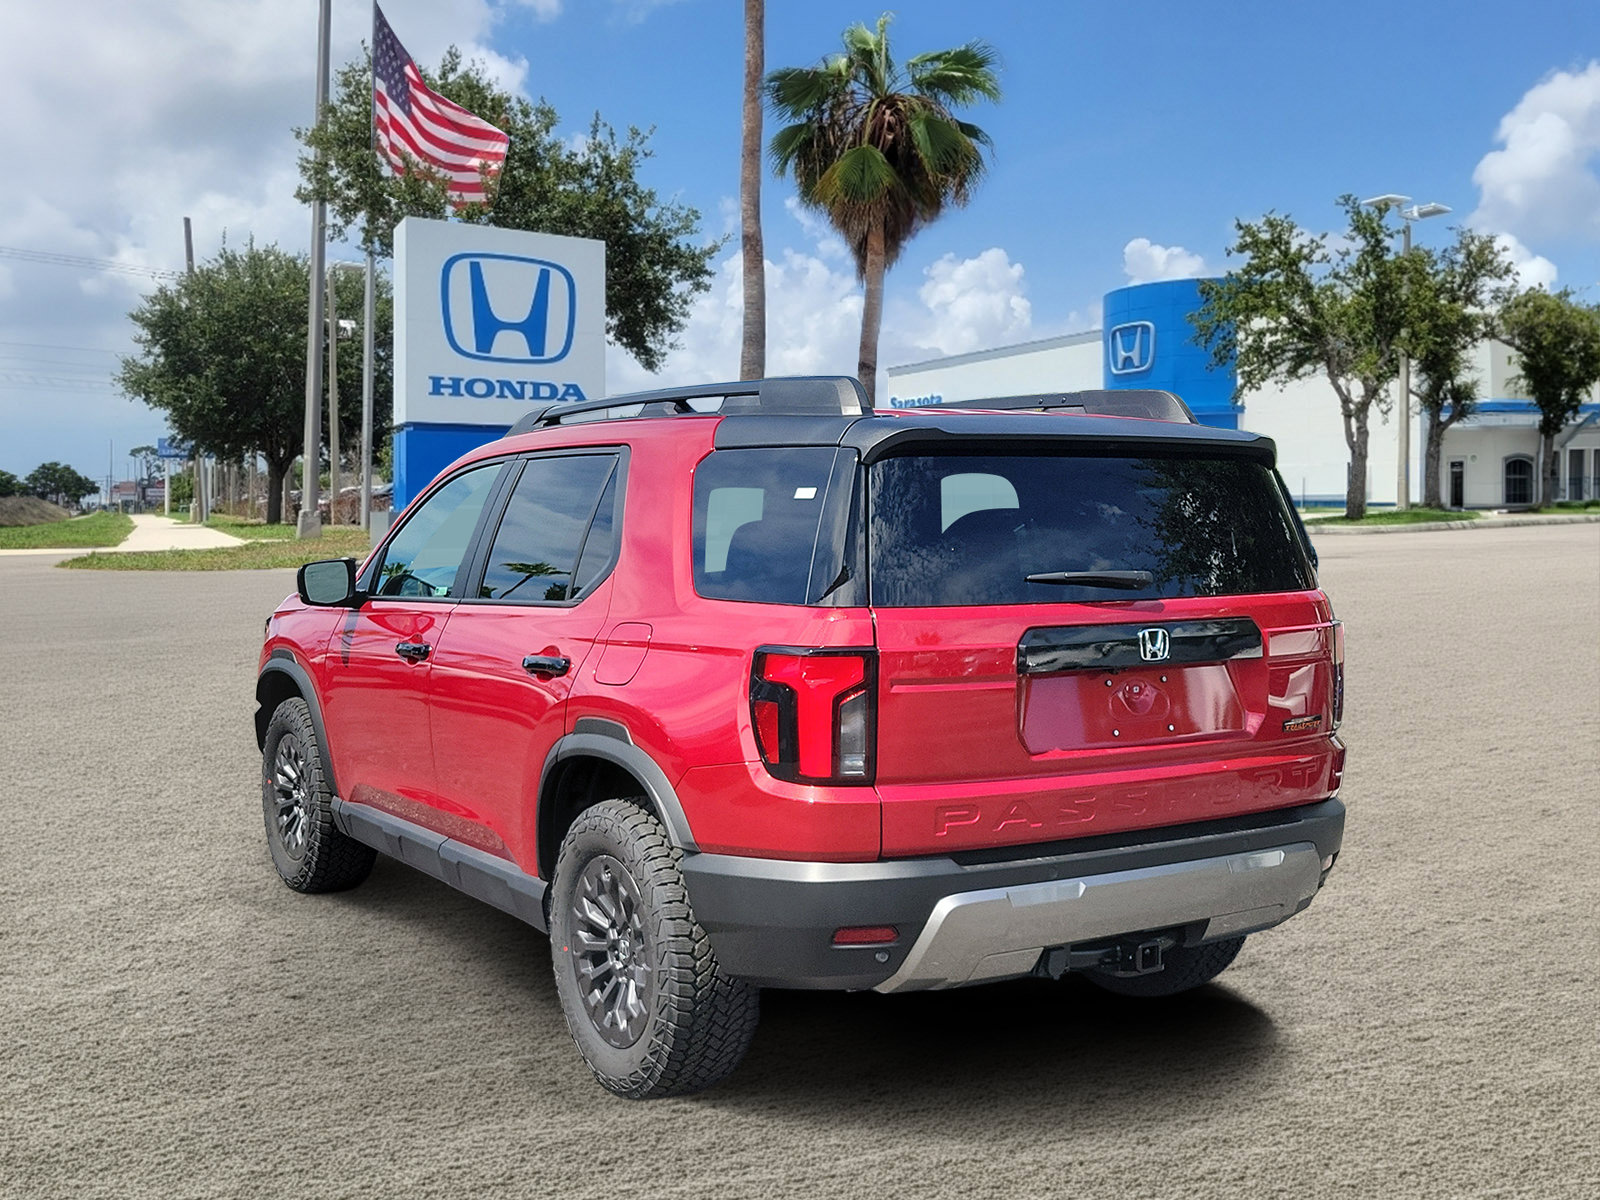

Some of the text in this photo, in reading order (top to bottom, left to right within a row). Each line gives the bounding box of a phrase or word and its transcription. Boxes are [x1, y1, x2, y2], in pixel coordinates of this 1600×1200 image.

[428, 376, 587, 402] HONDA
[890, 394, 943, 408] Sarasota
[934, 764, 1318, 837] PASSPORT
